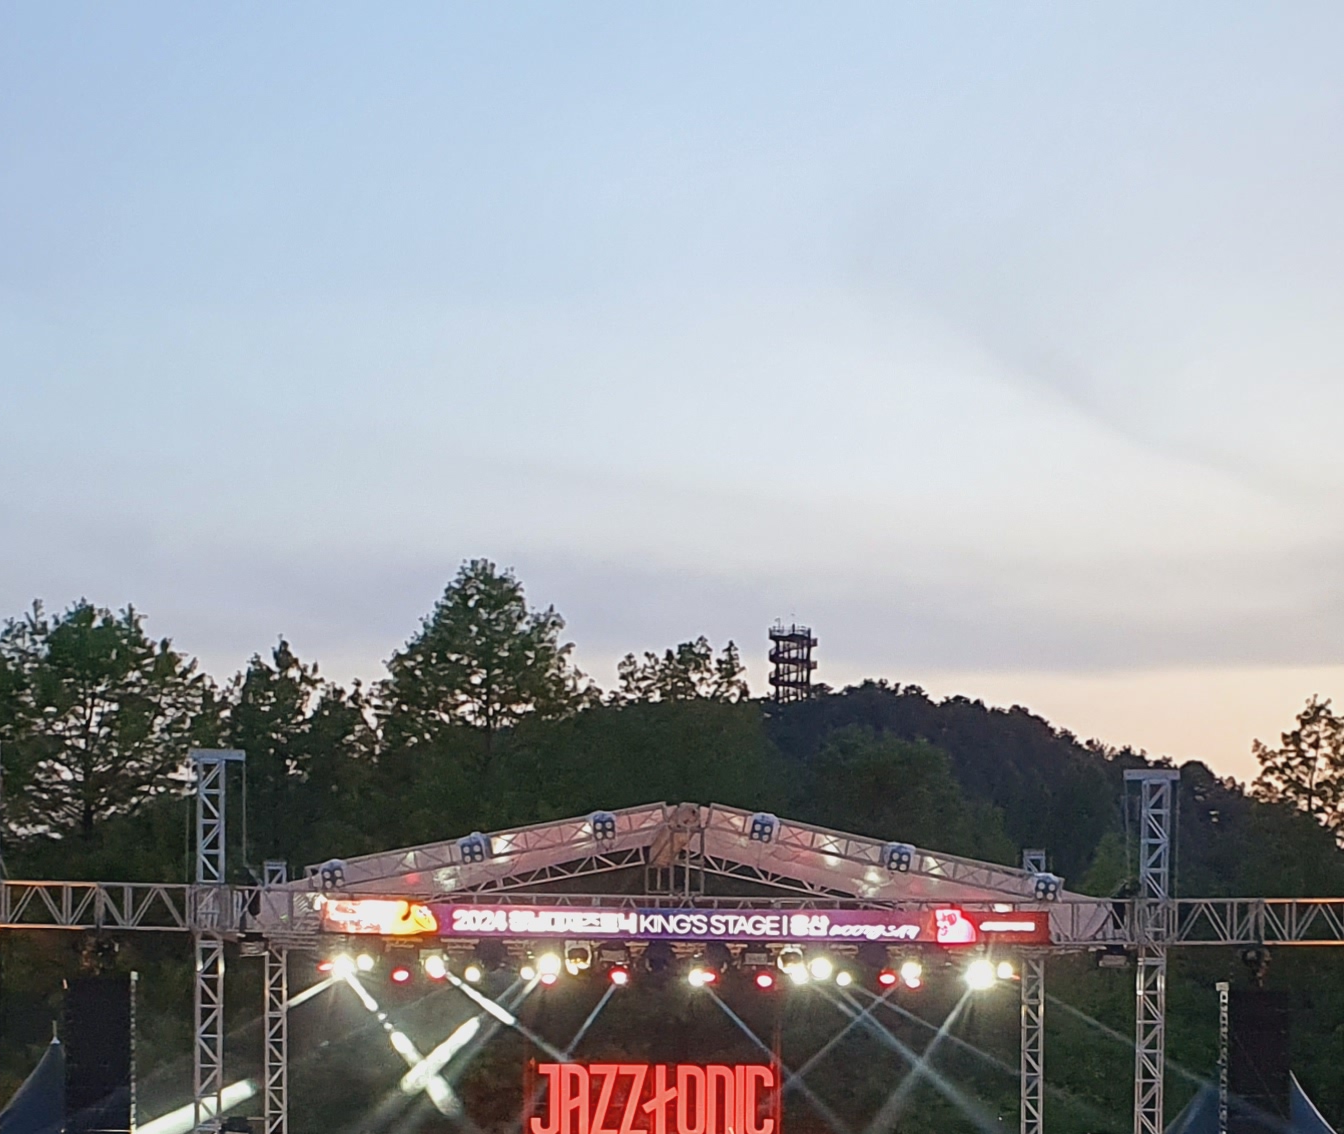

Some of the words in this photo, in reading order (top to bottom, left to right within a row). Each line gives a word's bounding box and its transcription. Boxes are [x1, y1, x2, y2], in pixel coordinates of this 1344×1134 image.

[453, 909, 507, 932] 2024
[640, 914, 707, 935] KING'S
[710, 914, 780, 936] STAGE
